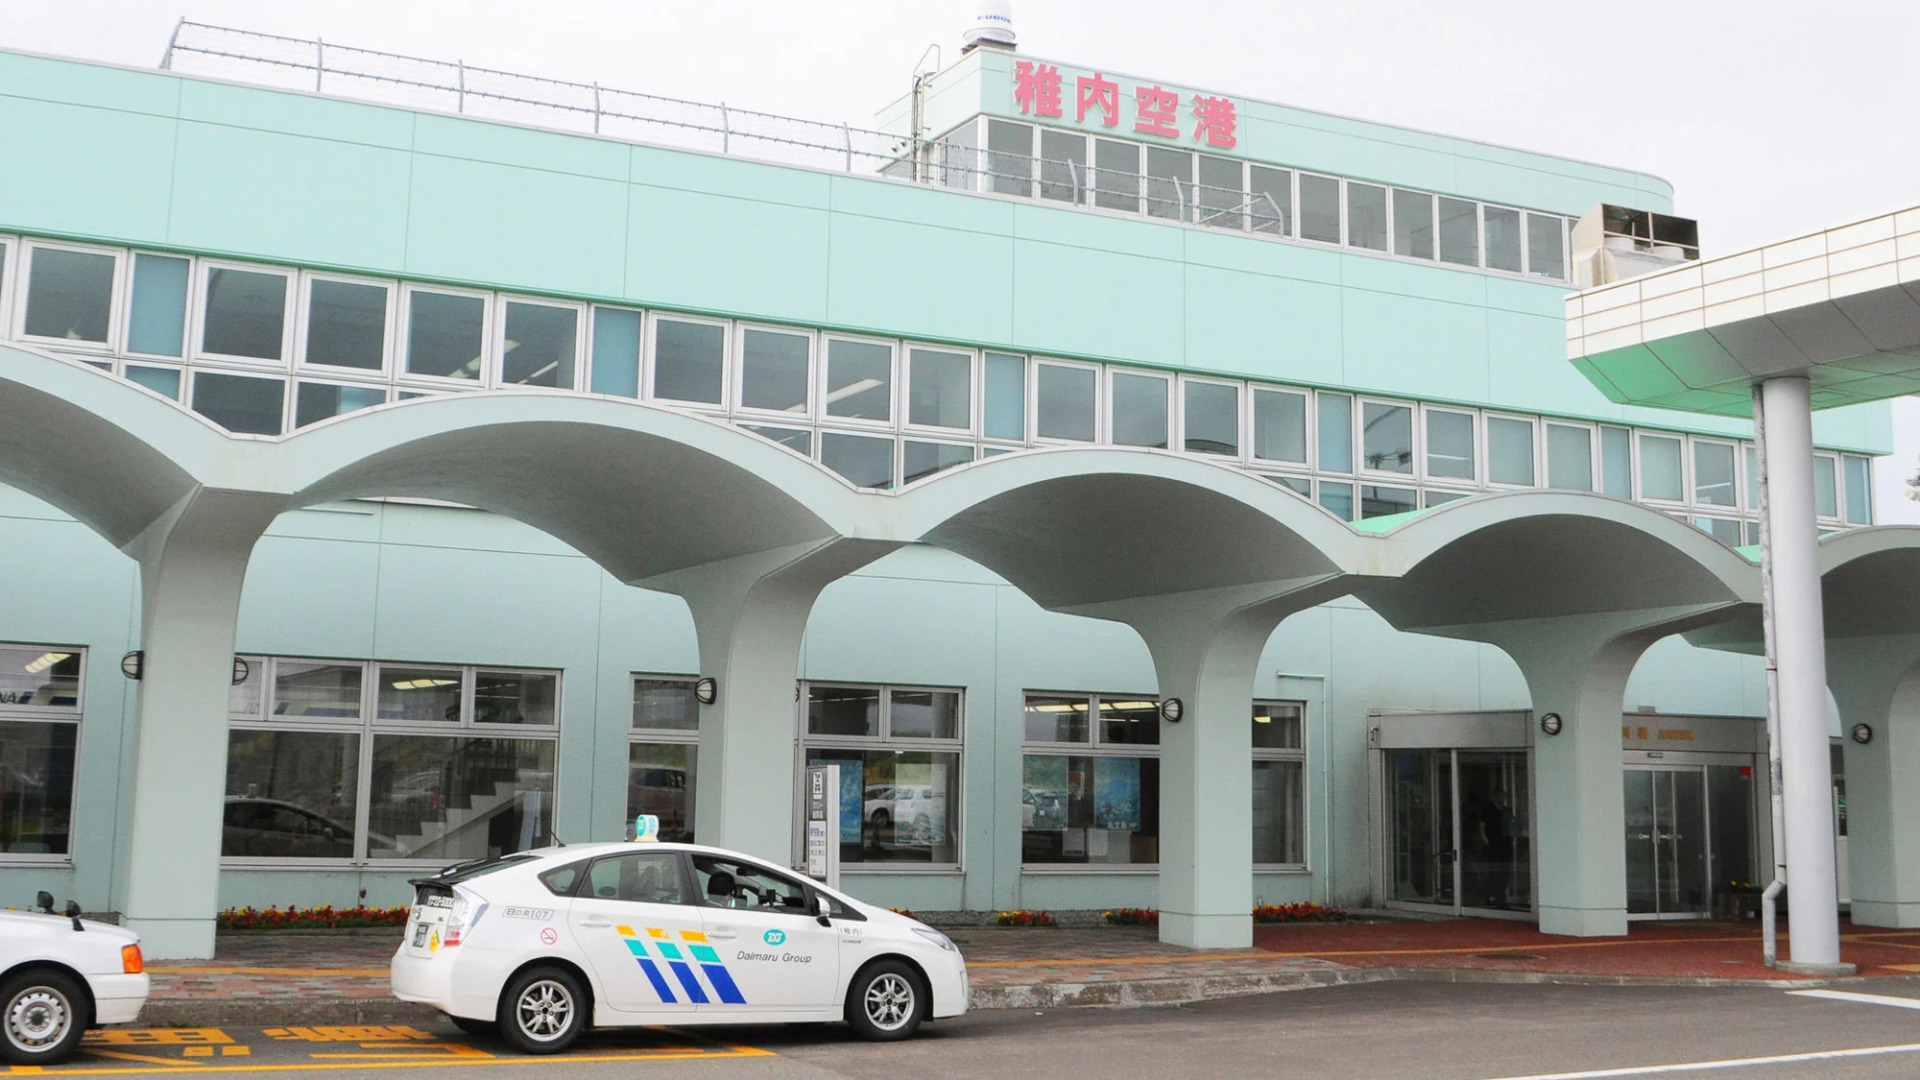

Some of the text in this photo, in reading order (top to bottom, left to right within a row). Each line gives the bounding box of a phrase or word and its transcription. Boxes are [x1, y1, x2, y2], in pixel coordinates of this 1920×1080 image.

[1014, 60, 1237, 148] 稚内空港
[736, 951, 812, 964] Daimaru Group
